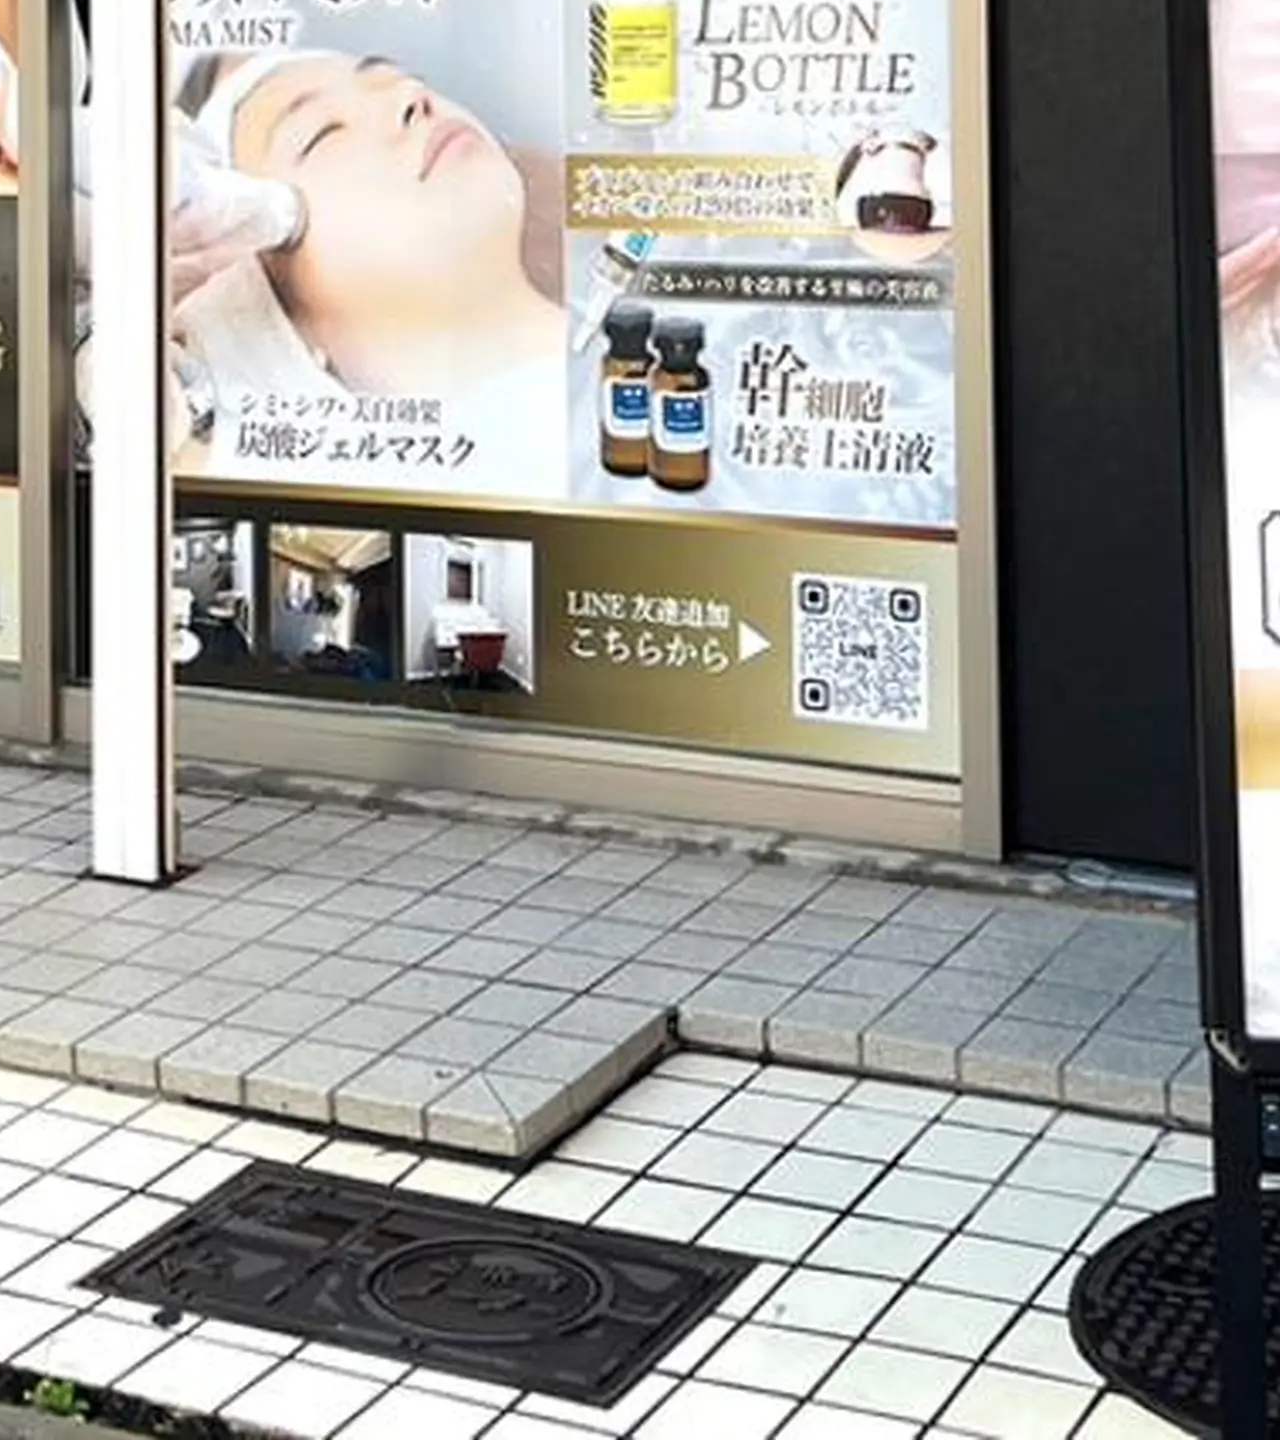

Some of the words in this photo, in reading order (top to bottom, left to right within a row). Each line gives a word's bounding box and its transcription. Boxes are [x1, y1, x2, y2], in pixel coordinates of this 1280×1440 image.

[219, 17, 295, 47] MIST
[705, 51, 917, 111] BOTTLE
[738, 340, 886, 425] 幹細胞
[234, 420, 477, 470] 炭酸ジェルマスク
[566, 589, 629, 621] LINE
[568, 625, 731, 676] こちらから
[838, 642, 879, 661] LINE
